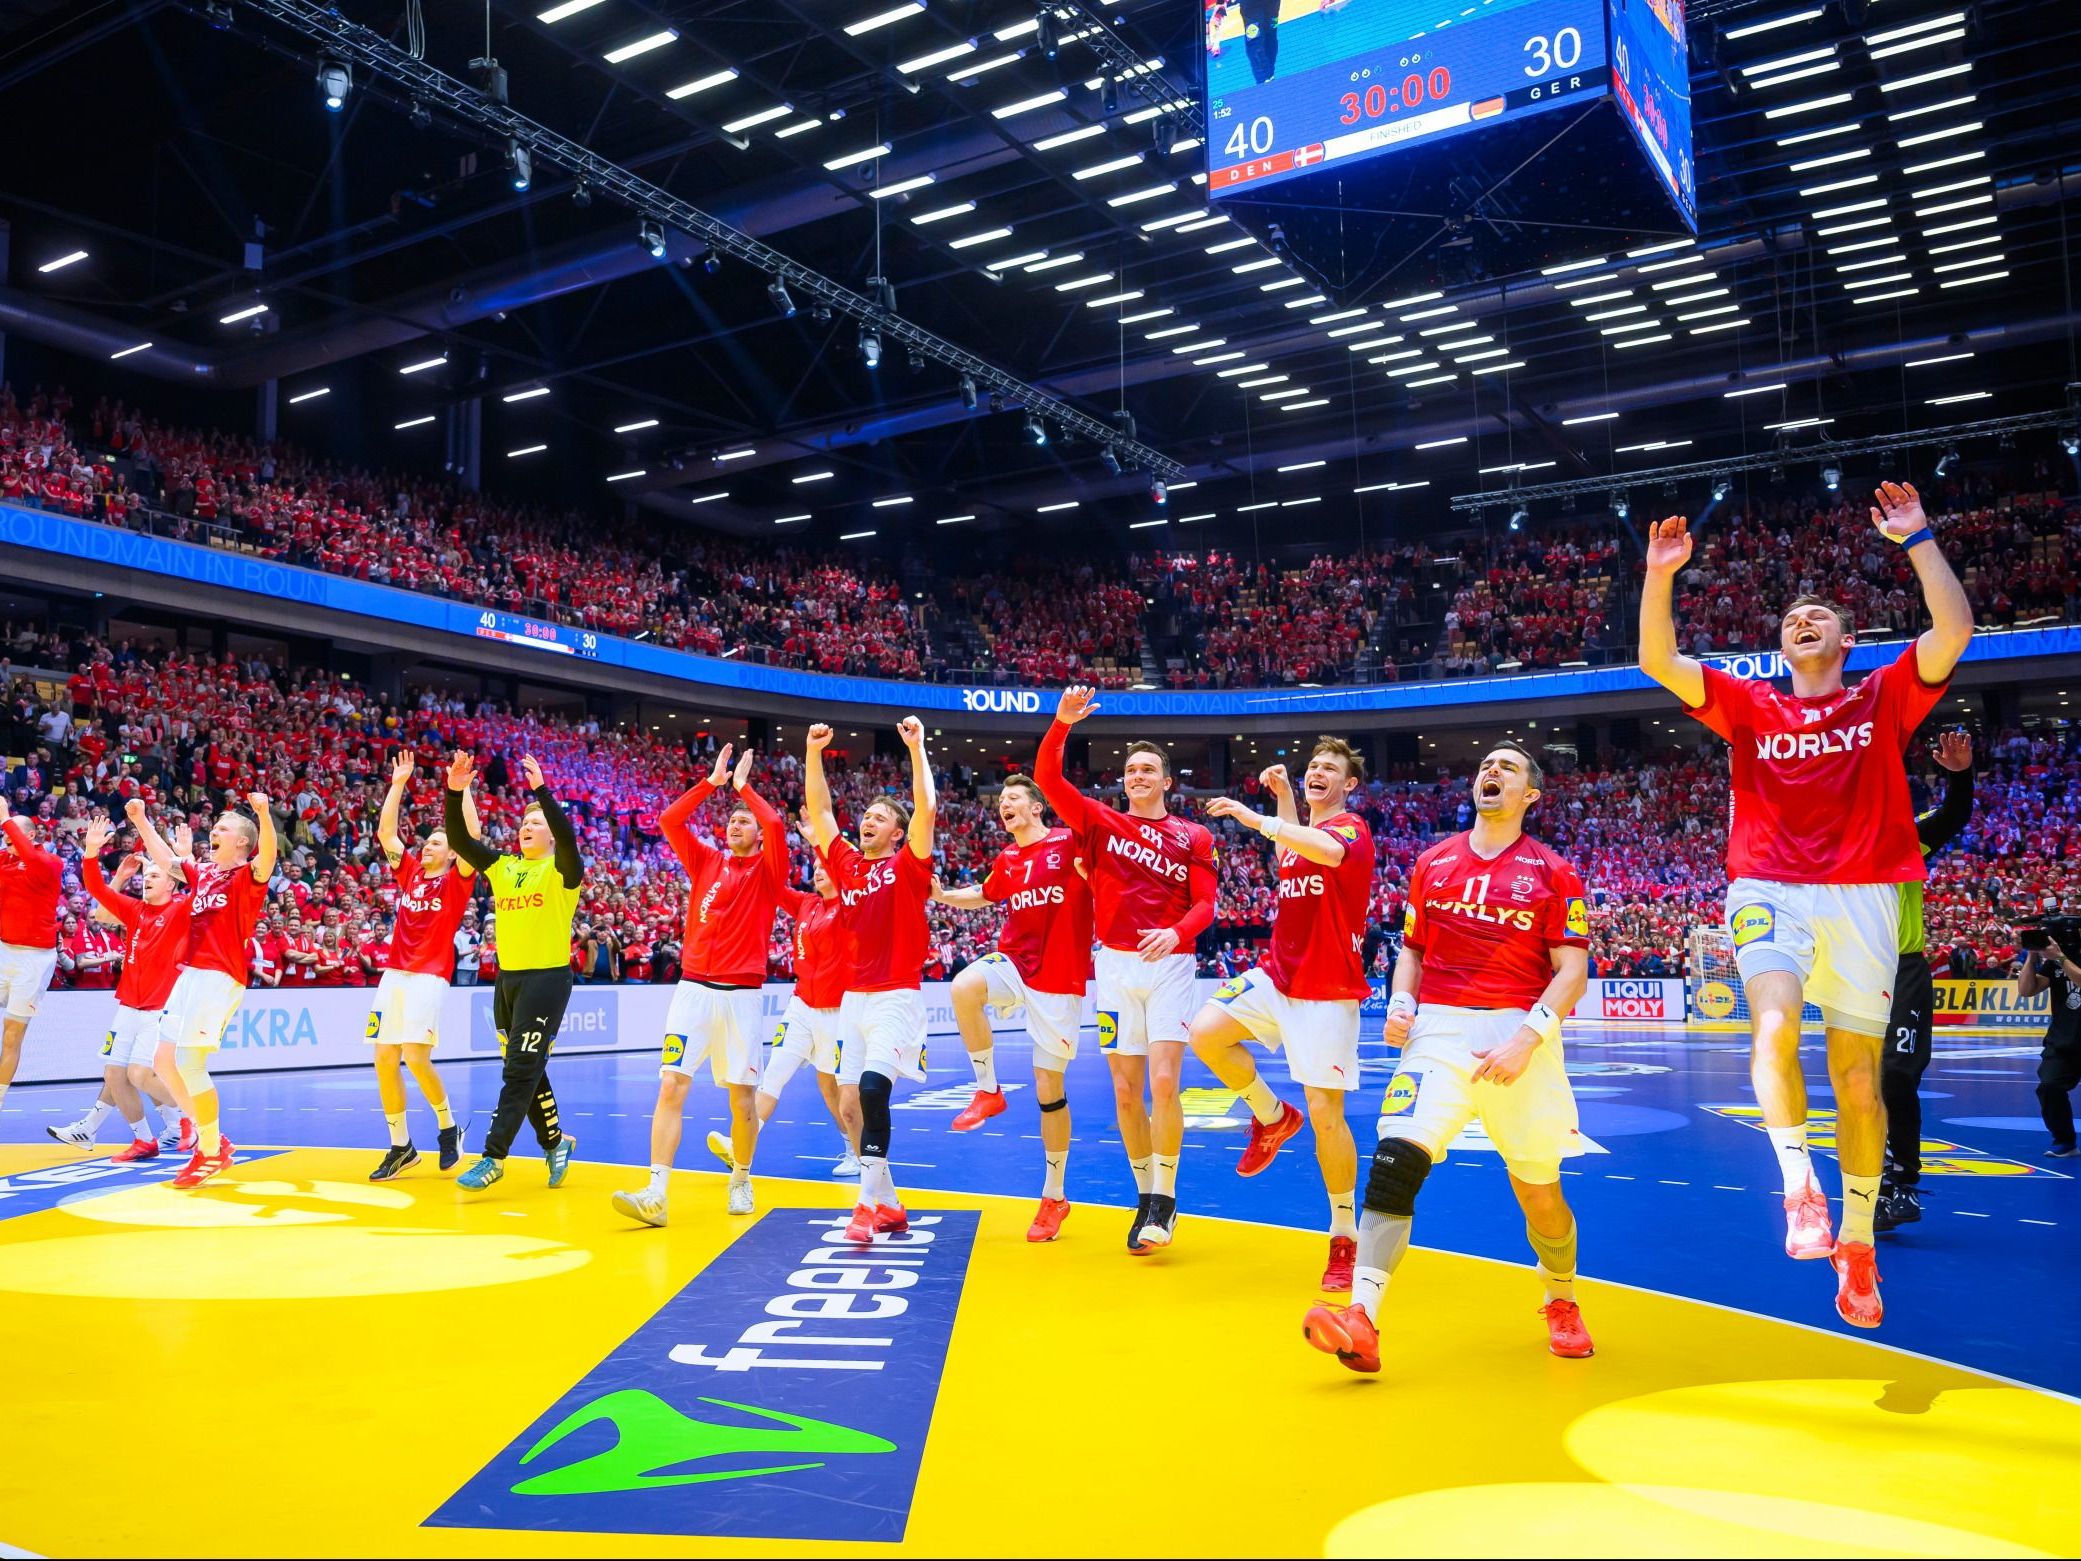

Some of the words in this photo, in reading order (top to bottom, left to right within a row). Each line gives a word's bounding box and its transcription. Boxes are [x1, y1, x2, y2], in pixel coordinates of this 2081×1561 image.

[1523, 27, 1582, 77] 30
[1615, 35, 1630, 85] 40
[1339, 66, 1451, 125] 30:00
[1529, 76, 1581, 100] GER
[1213, 107, 1232, 120] 1:52
[1224, 115, 1274, 159] 40
[1370, 120, 1422, 142] FINISHED
[1230, 161, 1272, 181] DEN
[1679, 148, 1691, 193] 30
[480, 612, 496, 628] 40
[583, 634, 597, 649] 30
[963, 689, 1040, 713] ROUND
[1755, 721, 1874, 760] NORLYS
[1023, 860, 1034, 884] 7
[1107, 835, 1188, 882] NORLYS
[1279, 874, 1324, 899] RLYS
[1462, 873, 1492, 905] 11
[700, 881, 722, 924] NORLYS
[1605, 981, 1661, 999] LIQUI
[559, 1007, 607, 1032] enet
[1605, 1000, 1663, 1017] MOLY
[221, 1007, 318, 1049] EKRA
[520, 1031, 542, 1053] 12
[1896, 1027, 1917, 1054] 20
[668, 1216, 943, 1372] freenet
